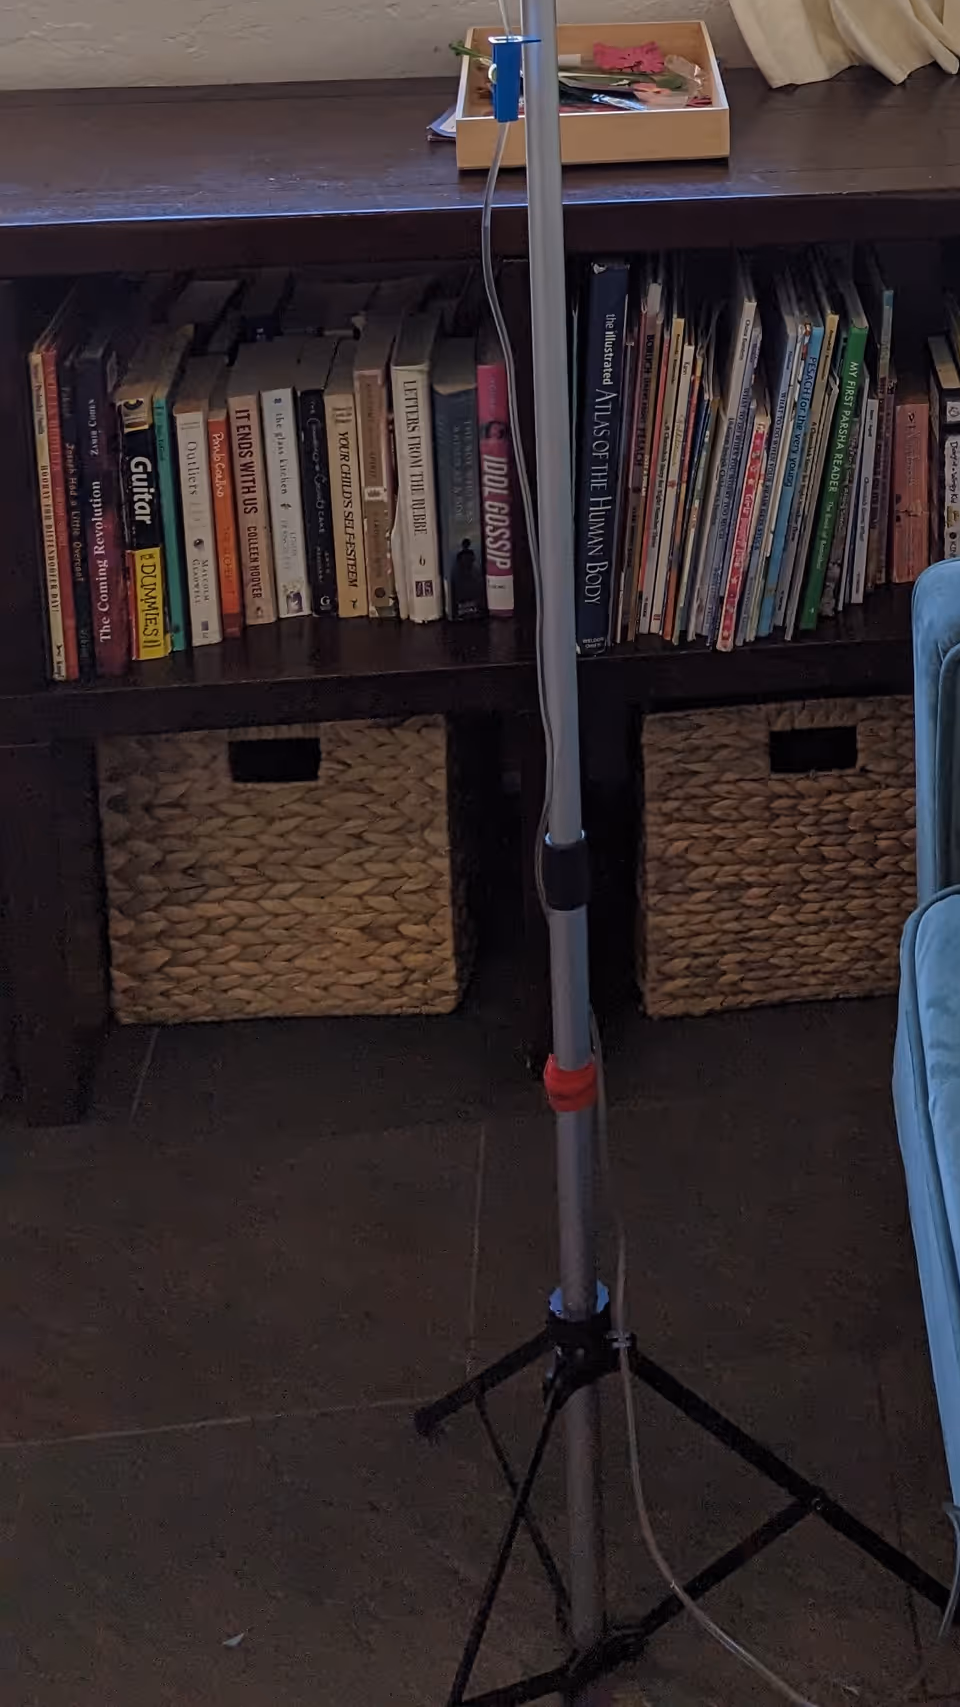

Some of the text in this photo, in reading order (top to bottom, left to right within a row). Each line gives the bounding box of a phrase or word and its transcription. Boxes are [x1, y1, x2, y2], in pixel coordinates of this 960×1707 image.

[847, 360, 859, 378] MY
[739, 387, 749, 408] WHAT
[776, 391, 786, 414] WHAT
[841, 379, 856, 407] FIRST
[737, 410, 746, 421] TO
[772, 427, 780, 439] DO
[774, 414, 782, 427] TO
[781, 356, 817, 488] PESACH for the very young
[834, 409, 851, 450] PARSHA
[234, 409, 258, 514] IT ENDS WITH US
[271, 412, 291, 495] the glass kitchen
[337, 430, 350, 461] YOUR
[402, 379, 428, 536] LETTERS FROM THE REBBE
[583, 313, 618, 605] the illustrated ATLAS OF THE HUMAN BODY
[767, 439, 778, 462] WHEN
[949, 440, 959, 459] Diary
[41, 464, 51, 500] HOORAY
[68, 477, 79, 496] Had
[184, 441, 202, 496] Outliers
[481, 453, 508, 496] IDOL
[764, 462, 774, 483] YOUR
[826, 451, 843, 493] READER
[948, 471, 959, 492] Wimpy
[128, 455, 156, 525] Guitar
[949, 492, 958, 504] Kid
[70, 509, 81, 536] Little
[483, 499, 512, 570] GOSSIP
[88, 480, 111, 641] The Coming Revolution
[245, 525, 263, 599] COLLEEN HOOVER
[342, 510, 359, 587] SELF-ESTEEM
[137, 563, 161, 637] DUMMIES
[190, 558, 202, 605] GLADWELL
[200, 558, 211, 601] MALCOLM
